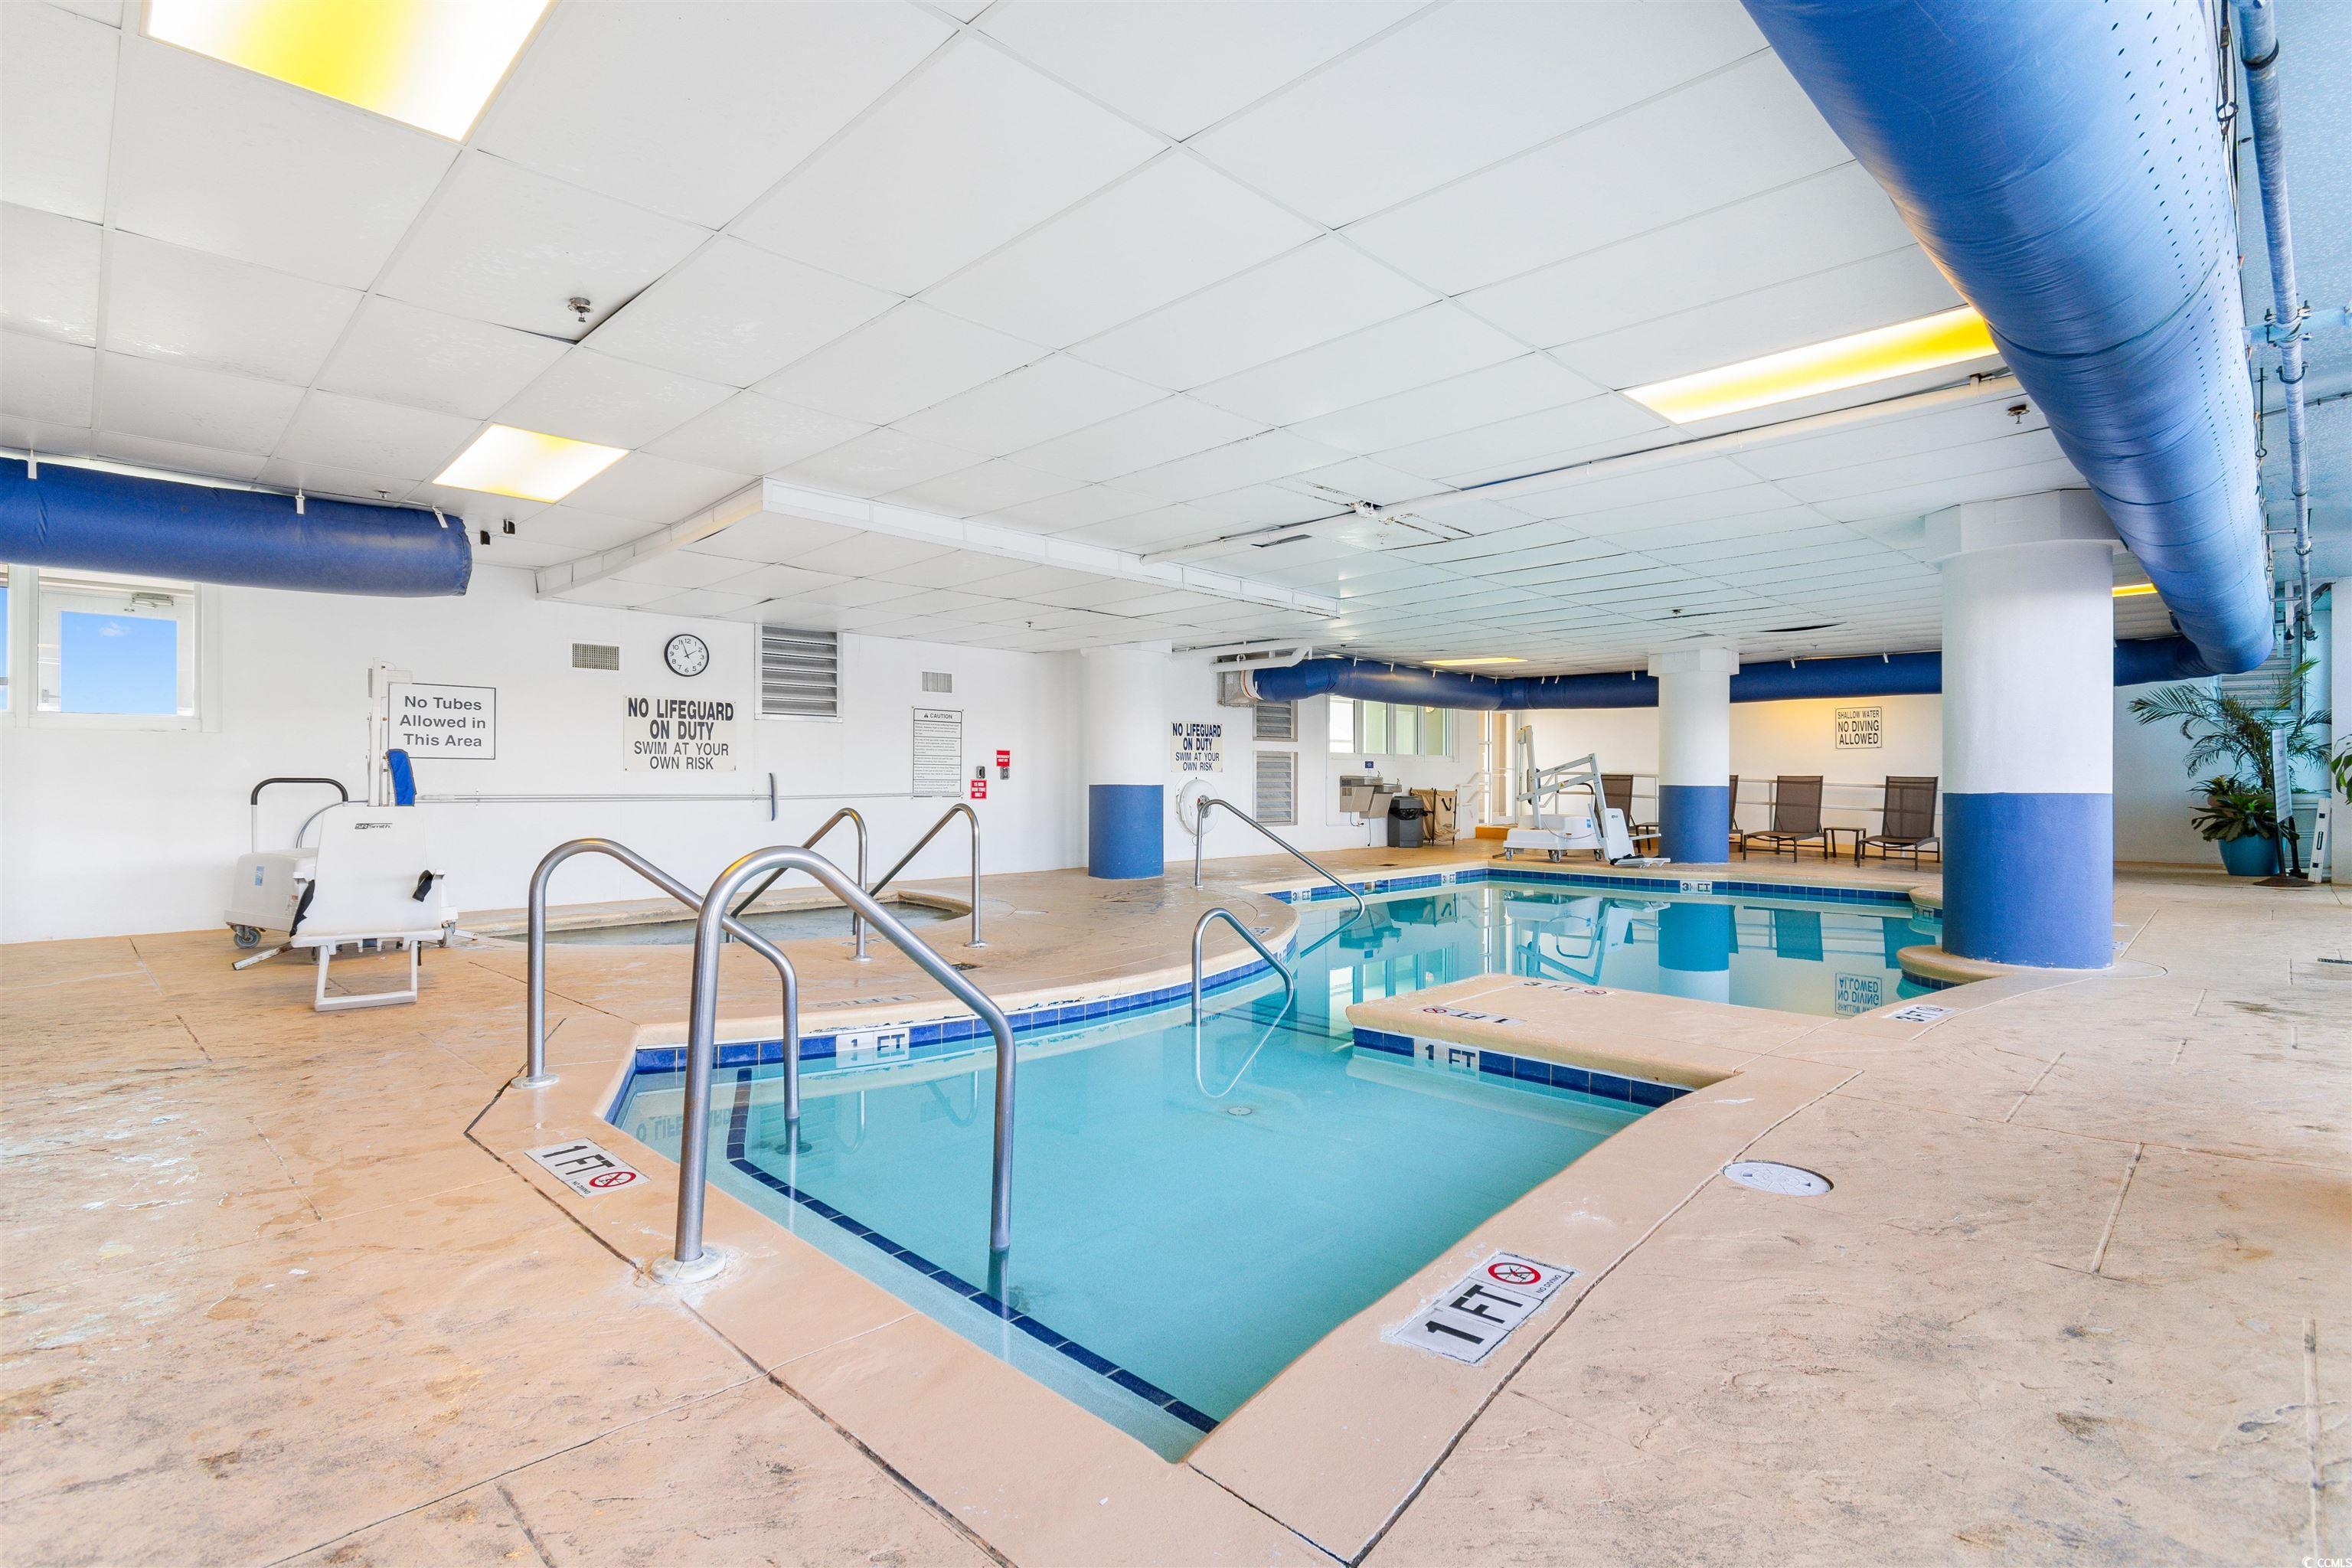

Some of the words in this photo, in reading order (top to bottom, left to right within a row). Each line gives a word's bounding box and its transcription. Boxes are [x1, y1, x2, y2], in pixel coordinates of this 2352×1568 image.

[404, 695, 427, 708] No
[433, 697, 482, 710] Tubes
[628, 697, 648, 717] NO
[657, 699, 733, 720] LIFEGUARD
[399, 714, 466, 728] Allowed
[472, 717, 486, 728] in
[1838, 710, 1860, 719] SHALLOW
[650, 720, 669, 740] ON
[678, 720, 714, 740] DUTY
[1173, 723, 1183, 736] NO
[1187, 724, 1221, 737] LIFEGUARD
[1838, 721, 1849, 732] NO
[1852, 720, 1879, 732] DIVING
[403, 733, 439, 746] This
[444, 734, 482, 747] Area
[1183, 737, 1192, 750] ON
[1196, 738, 1212, 750] DUTY
[1839, 733, 1879, 745] ALLOWED
[634, 741, 667, 754] SWIM
[674, 742, 689, 755] AT
[696, 743, 729, 756] YOUR
[650, 756, 679, 769] OWN
[686, 757, 714, 769] RISK
[1176, 752, 1191, 761] SWIM
[1194, 753, 1201, 761] AT
[1204, 753, 1219, 761] YOUR
[1183, 762, 1197, 771] OWN
[1200, 763, 1213, 771] RISK
[1425, 1044, 1434, 1060] 1
[1449, 1047, 1476, 1068] FT
[542, 1145, 588, 1158] 1
[554, 1154, 616, 1174] FT
[1544, 1275, 1562, 1288] DIVING
[1449, 1284, 1523, 1324] FT
[1425, 1321, 1485, 1345] 1
